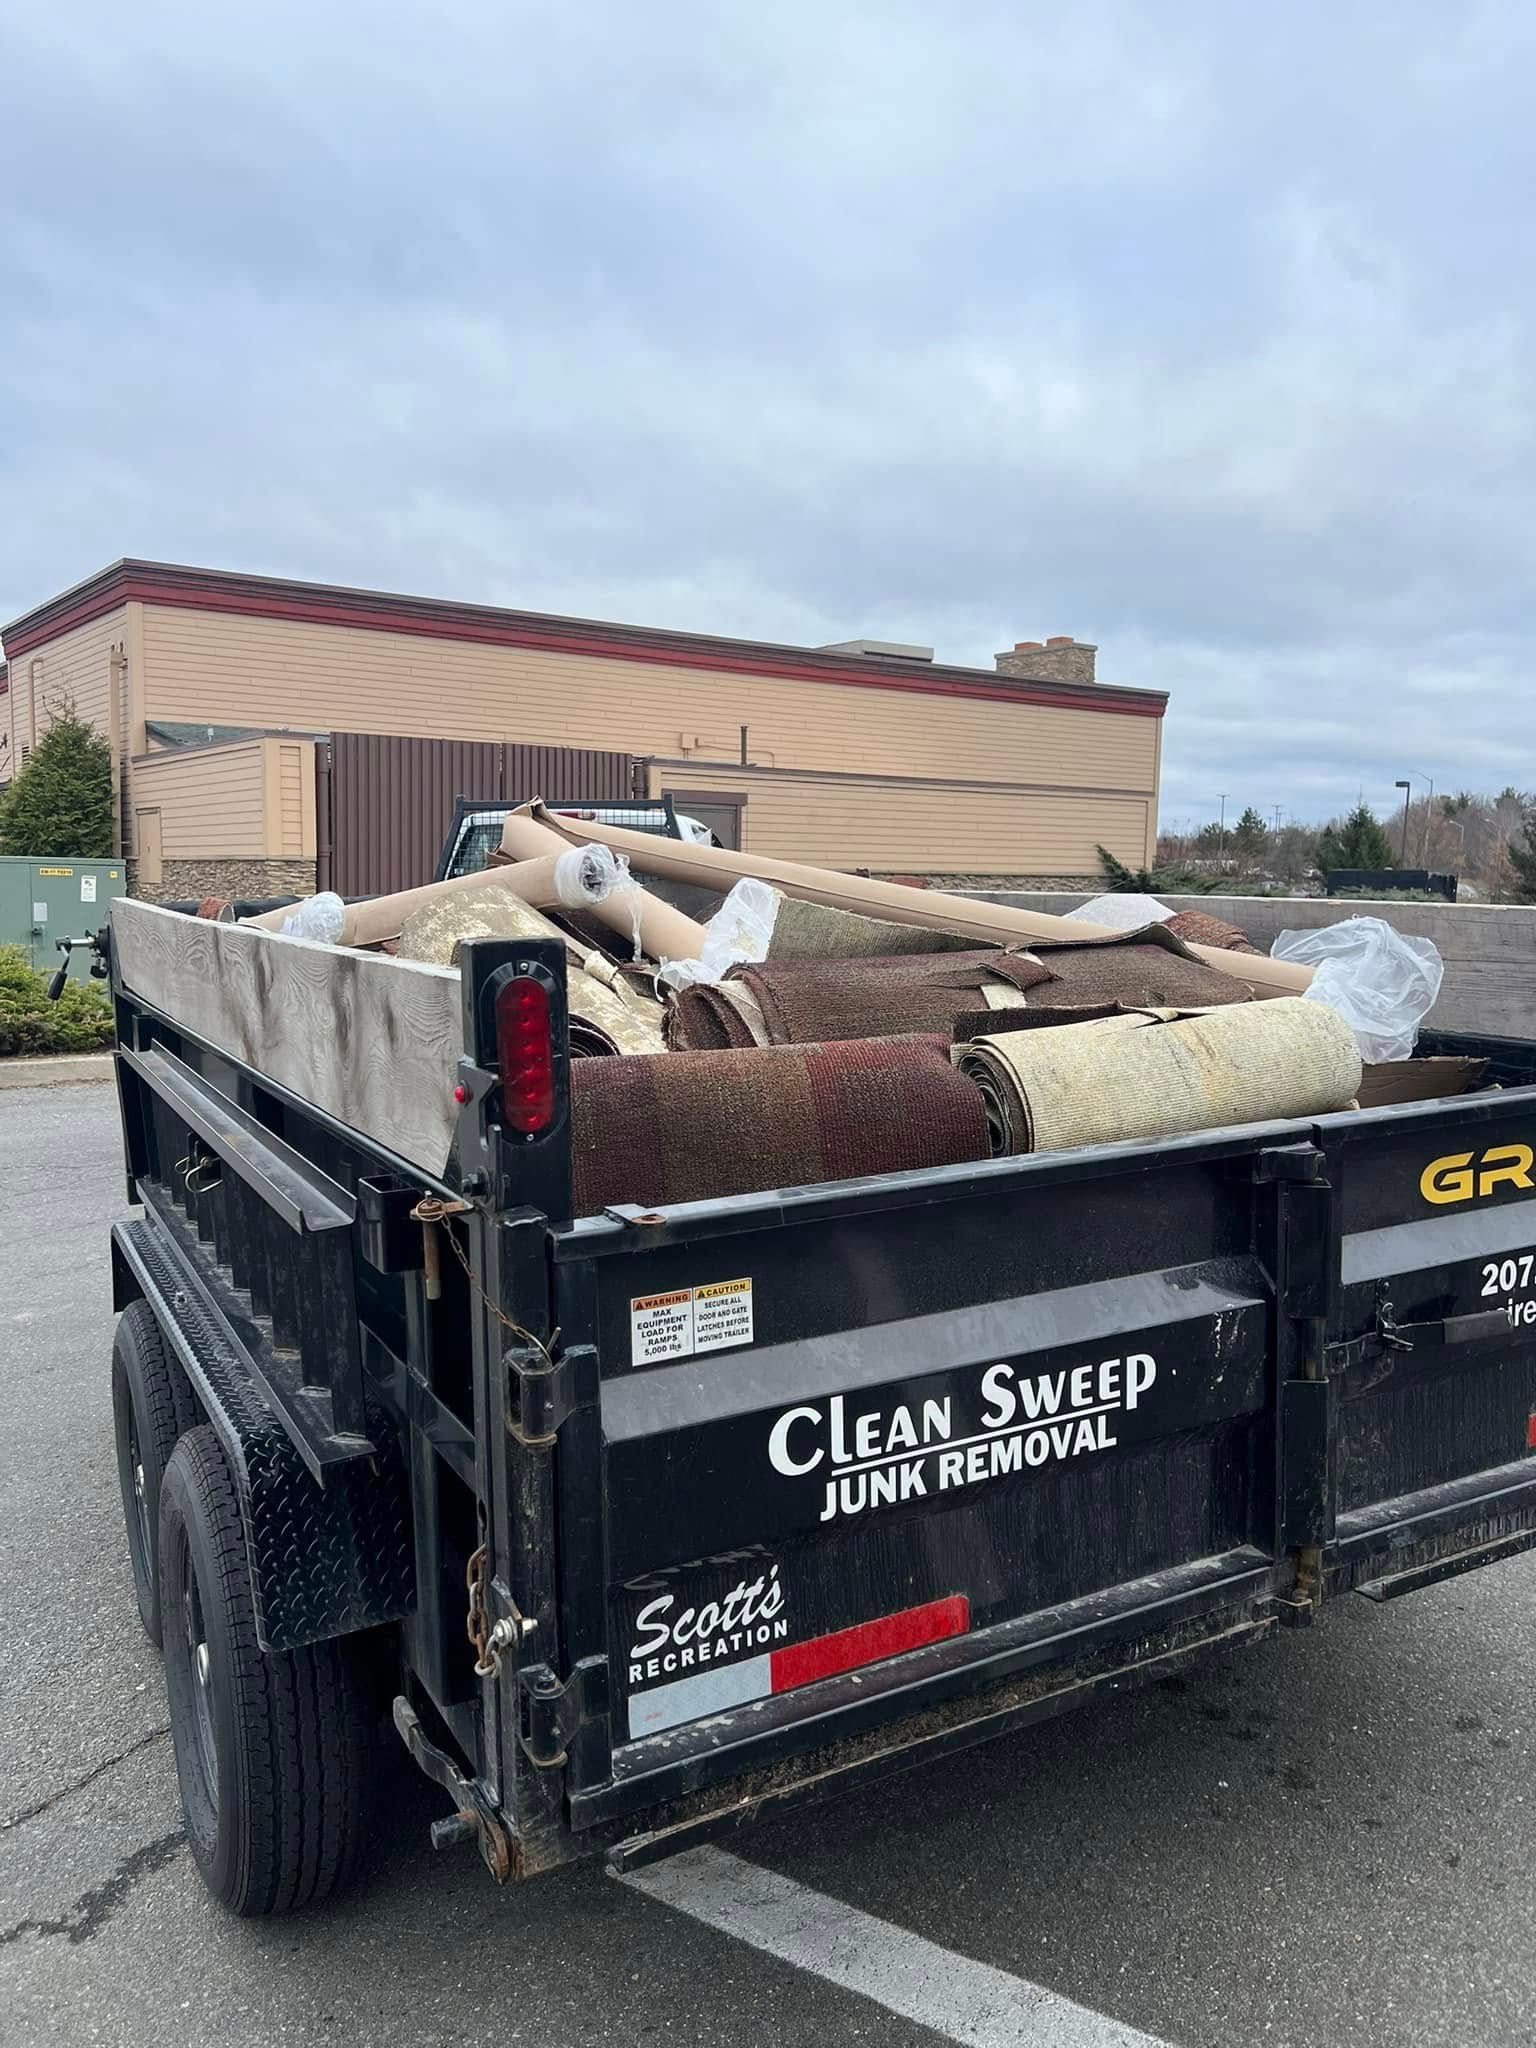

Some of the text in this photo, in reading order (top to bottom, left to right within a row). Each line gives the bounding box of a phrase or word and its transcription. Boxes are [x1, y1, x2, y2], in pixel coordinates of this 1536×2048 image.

[1420, 1144, 1535, 1204] GR
[1481, 1255, 1536, 1296] 207
[706, 1282, 746, 1296] CAUTION
[645, 1293, 689, 1307] WARNING
[704, 1296, 741, 1309] SECURE ALL
[652, 1308, 672, 1318] MAX
[698, 1306, 748, 1321] DOOR AND GATE
[637, 1314, 687, 1330] EQUIPMENT
[697, 1317, 750, 1333] LATCHES BEFORE
[641, 1324, 684, 1338] LOAD FOR
[698, 1327, 750, 1343] MOVING TRAILER
[648, 1334, 678, 1346] RAMPS
[644, 1345, 667, 1356] 5,000
[820, 1414, 1118, 1522] JUNK REMOVAL
[630, 1564, 785, 1659] Scott's
[628, 1618, 788, 1684] RECREATION
